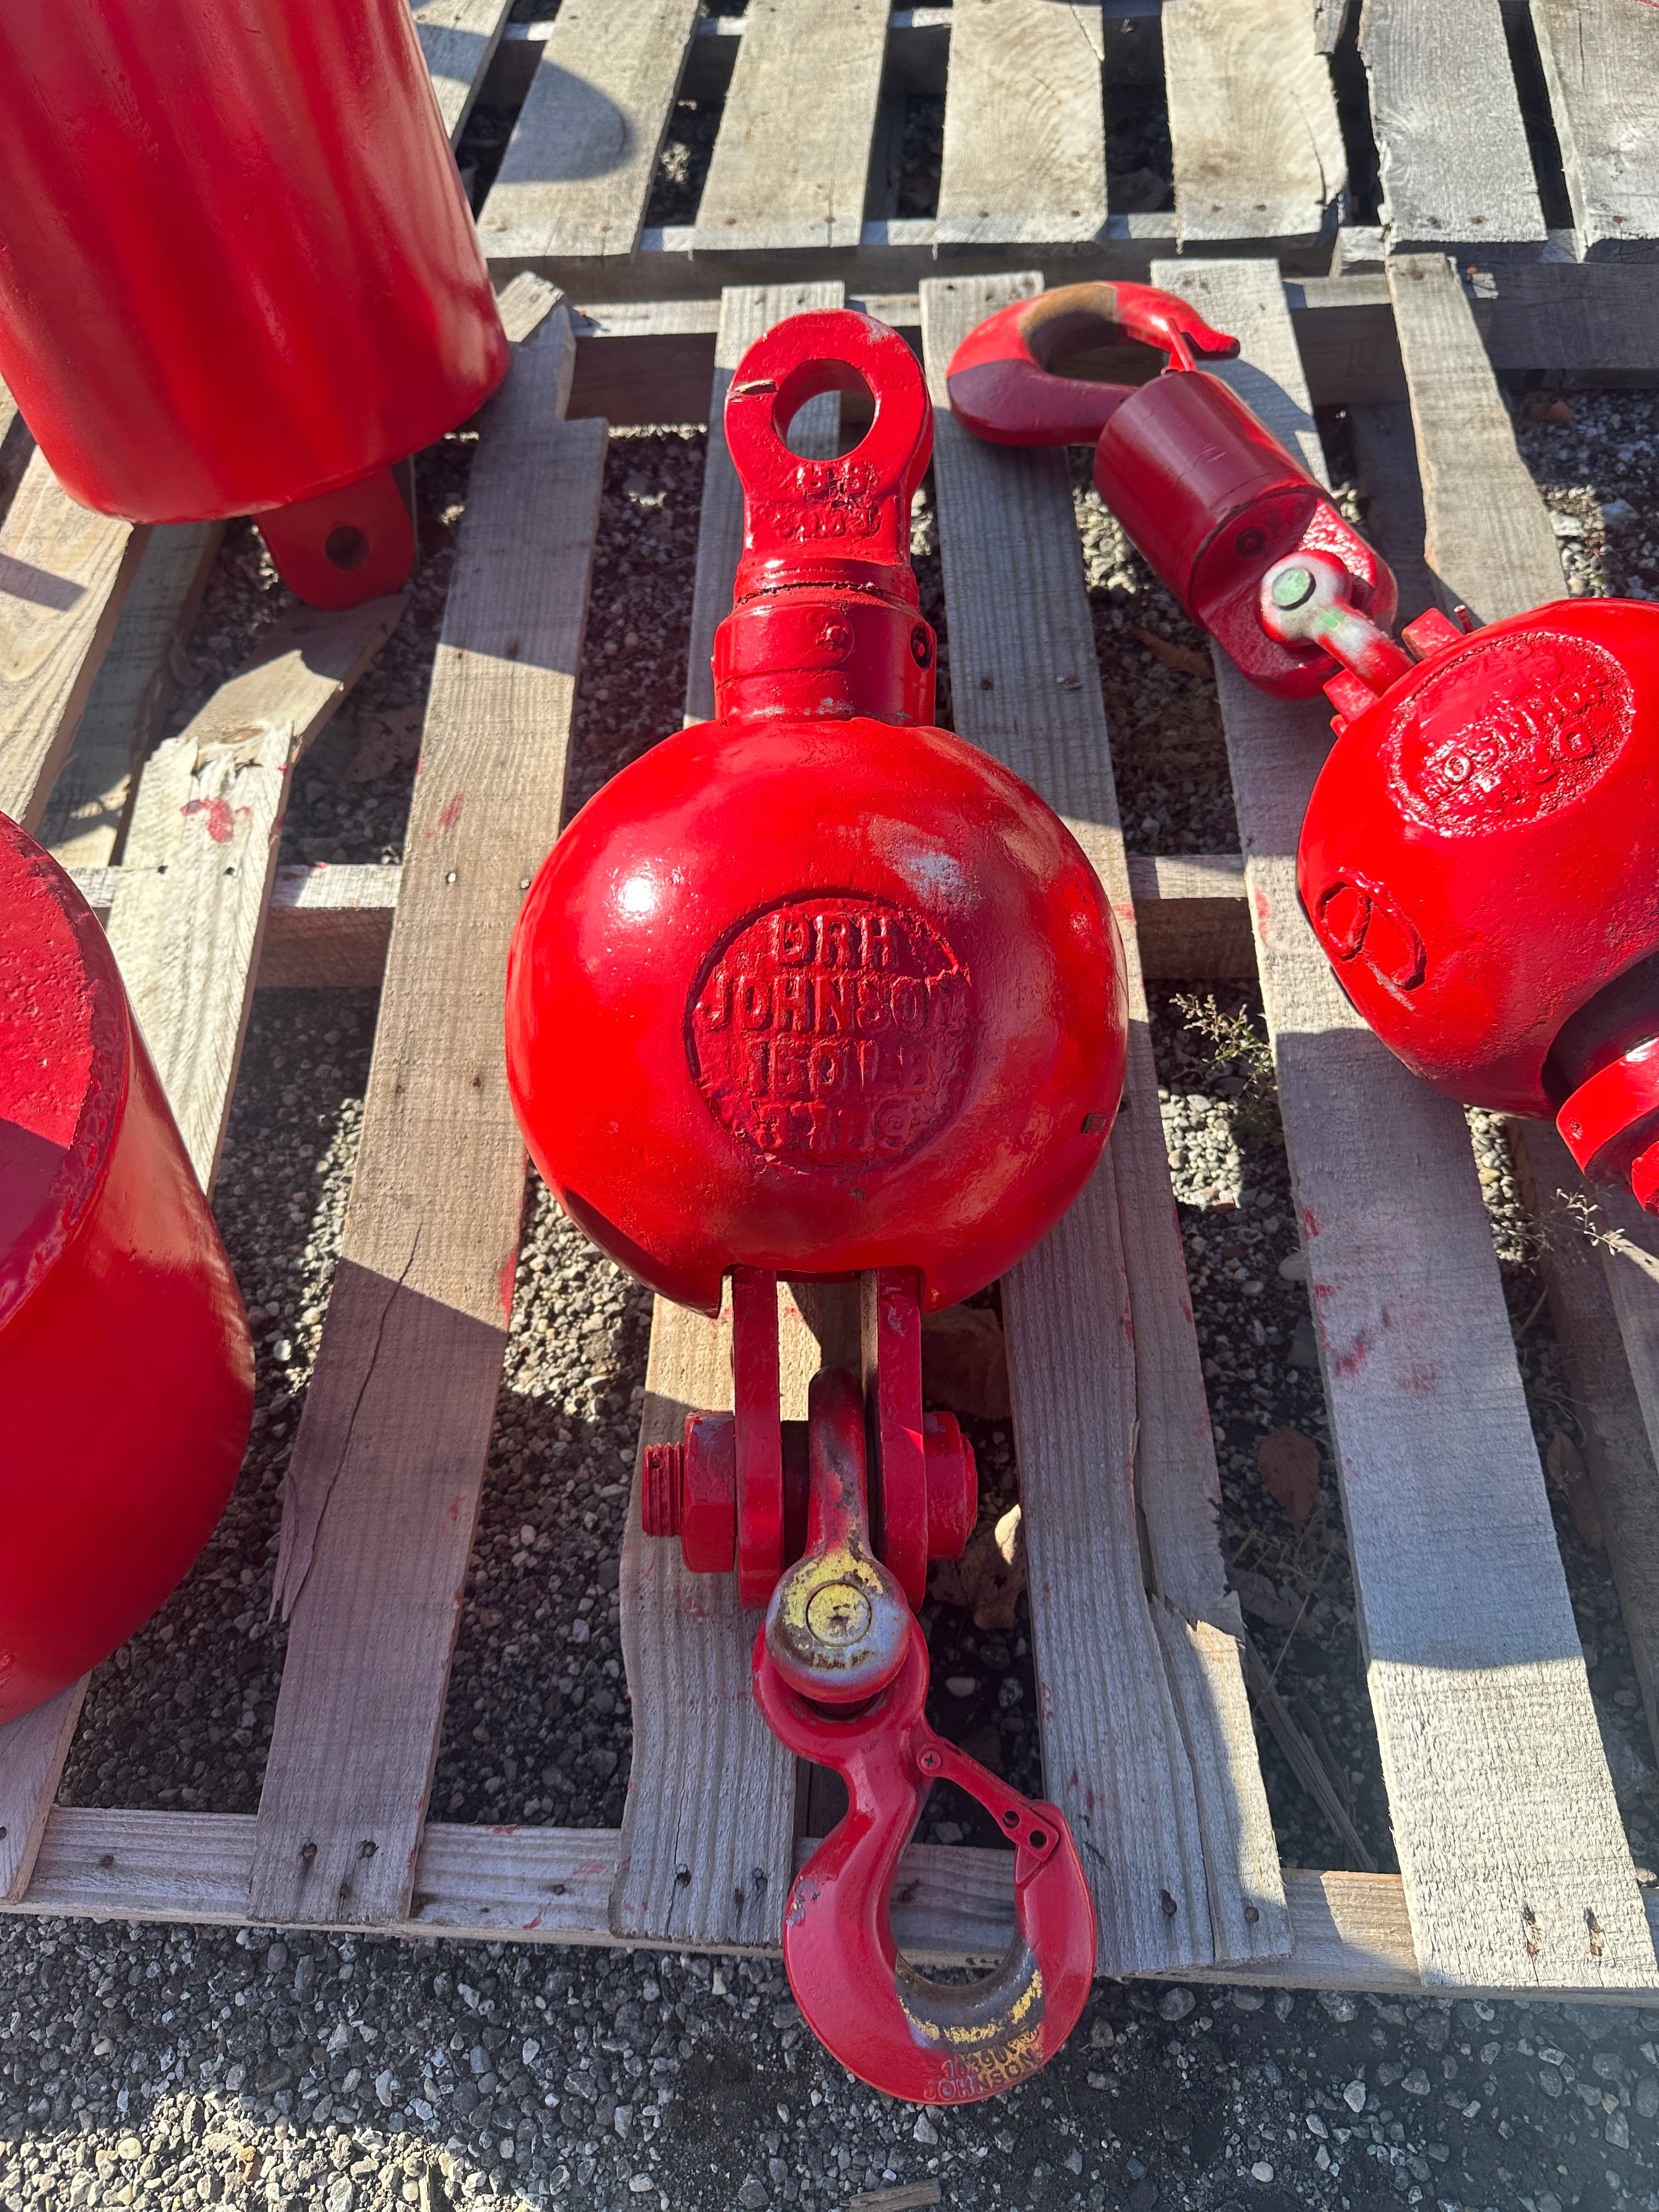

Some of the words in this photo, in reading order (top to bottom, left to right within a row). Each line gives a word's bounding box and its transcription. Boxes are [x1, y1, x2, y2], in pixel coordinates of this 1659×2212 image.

[772, 912, 900, 968] DRH
[695, 972, 967, 1036] JOHNSON
[923, 2047, 1042, 2101] JOHNSON
